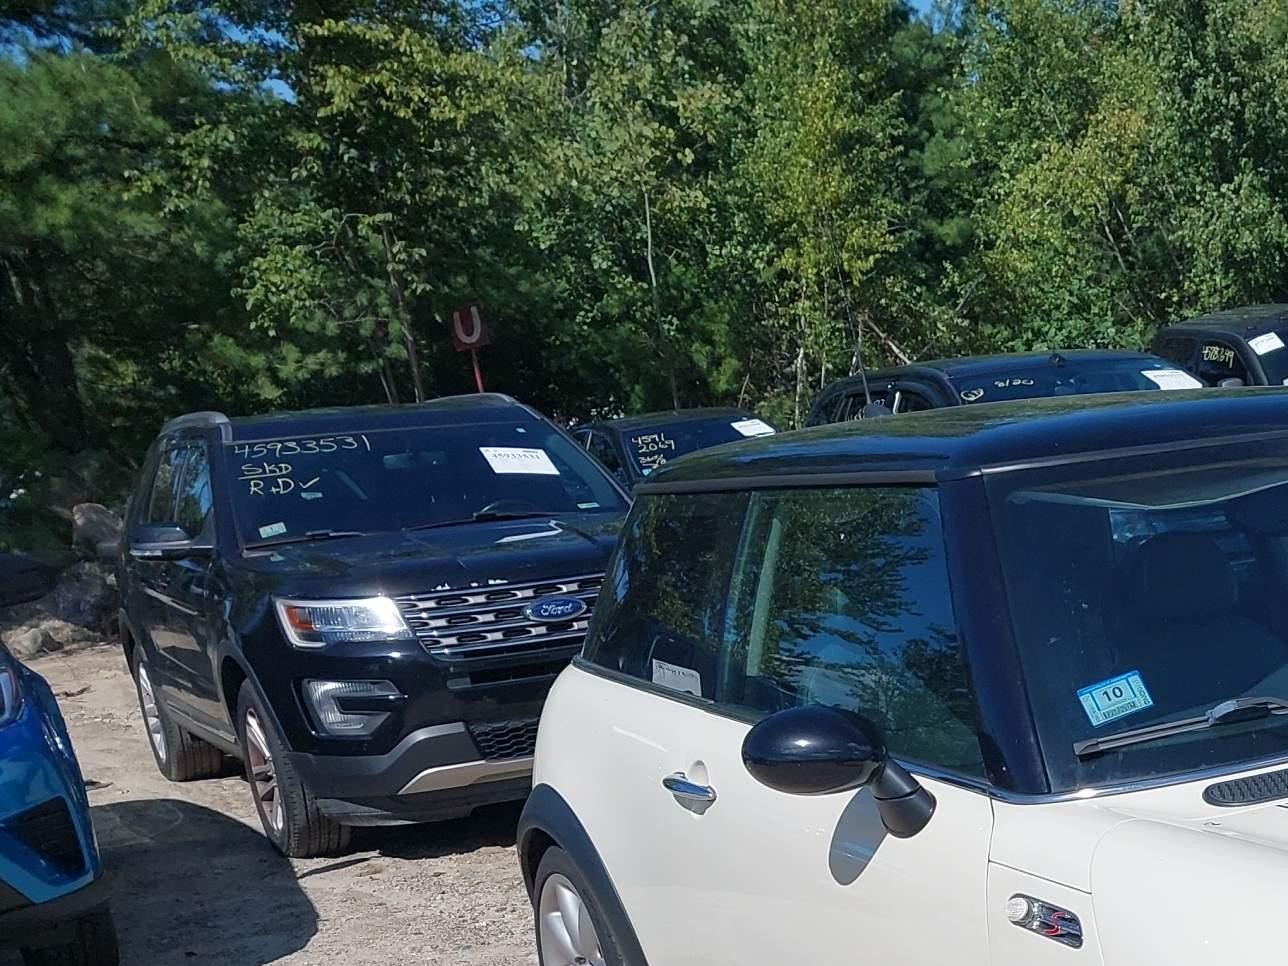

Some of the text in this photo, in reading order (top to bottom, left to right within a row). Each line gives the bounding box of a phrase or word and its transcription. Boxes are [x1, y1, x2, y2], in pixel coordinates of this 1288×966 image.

[453, 306, 481, 344] U
[234, 433, 371, 458] 45933531
[631, 432, 665, 446] 4591
[638, 439, 675, 454] 2069
[242, 462, 293, 475] SKD
[540, 602, 573, 616] Ford
[1102, 686, 1124, 702] 10
